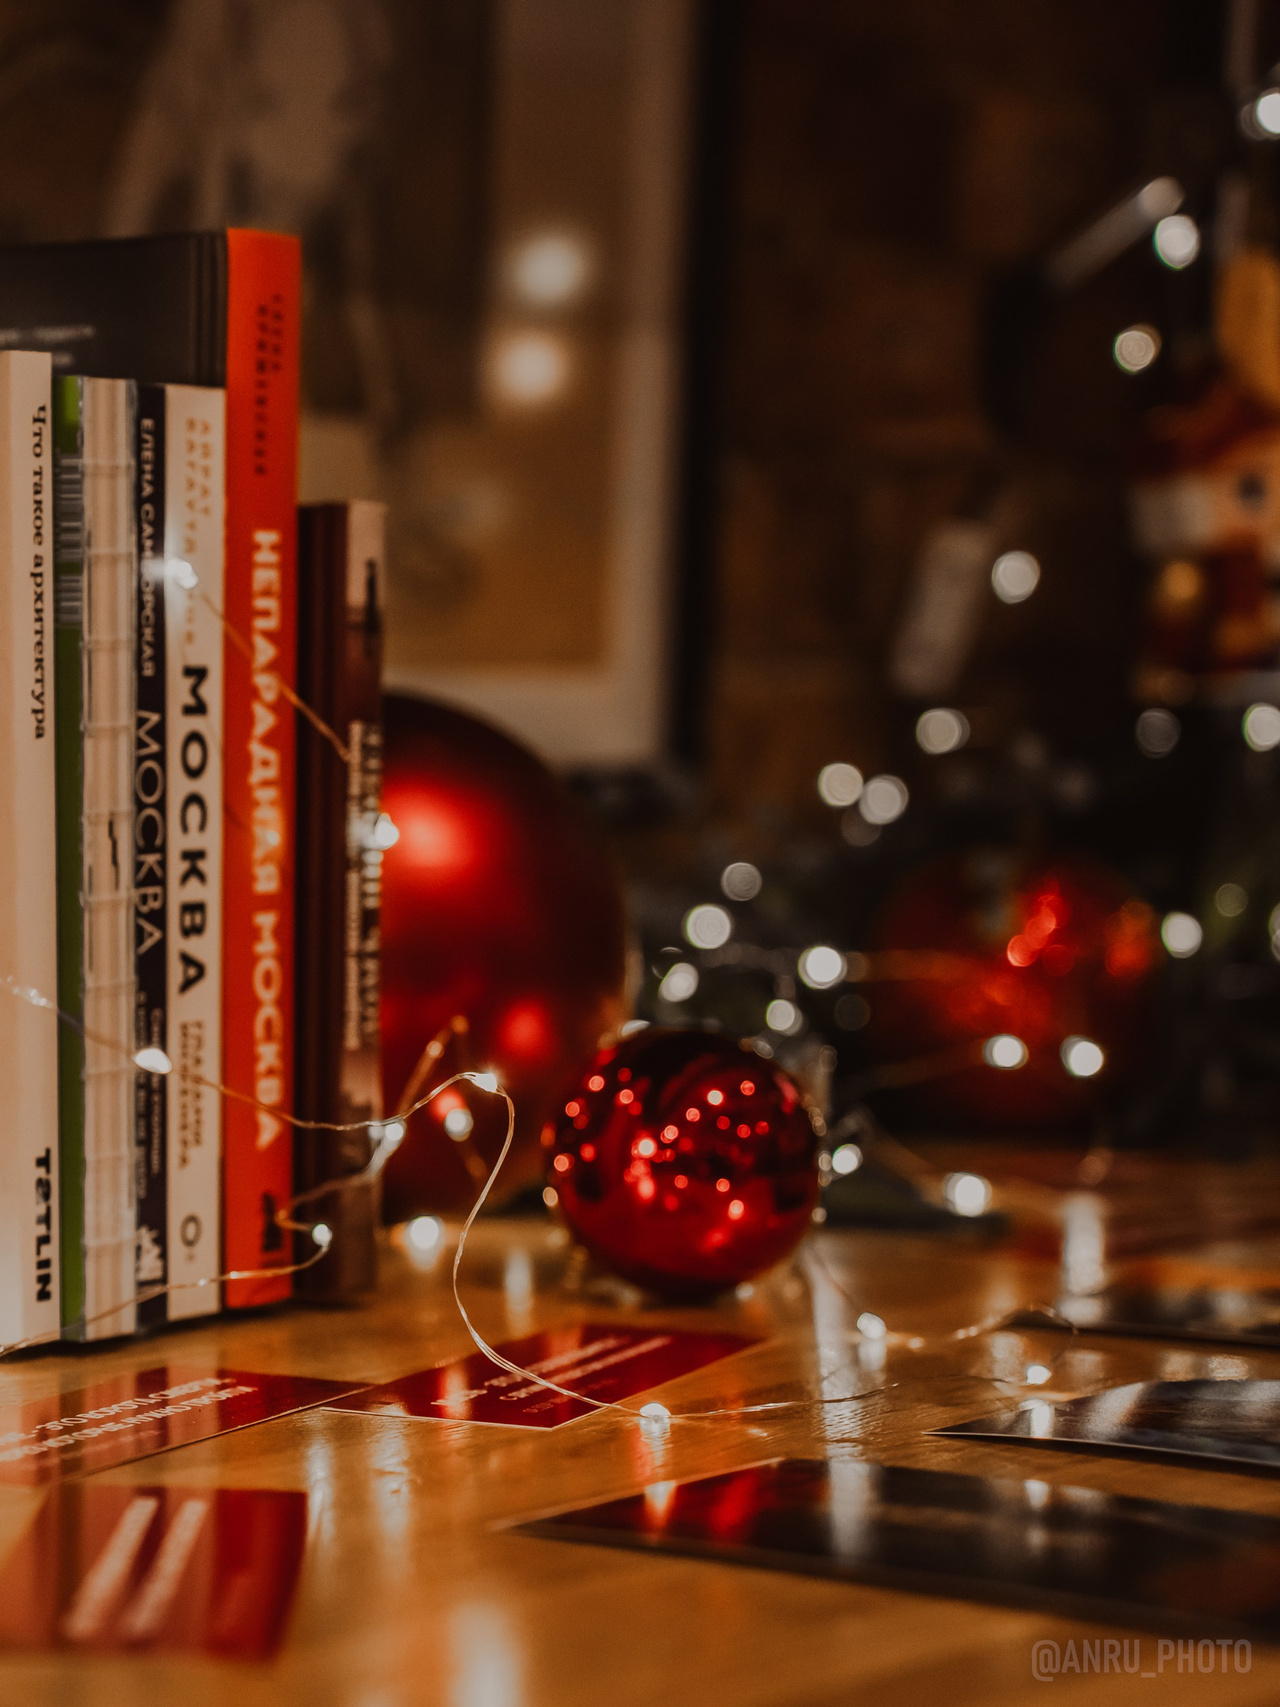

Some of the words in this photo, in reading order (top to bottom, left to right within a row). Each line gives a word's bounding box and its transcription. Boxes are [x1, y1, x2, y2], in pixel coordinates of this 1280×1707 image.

[32, 404, 47, 458] Что
[33, 466, 44, 546] такое
[140, 418, 155, 498] ЕЛЕНА
[30, 554, 46, 739] архитектура
[140, 502, 155, 677] САМОРСКАЯ
[248, 529, 282, 895] НЕПАРАДНАЯ
[135, 709, 164, 955] МОСКВА
[178, 664, 209, 995] МОСКВА
[251, 910, 284, 1151] МОСКВА
